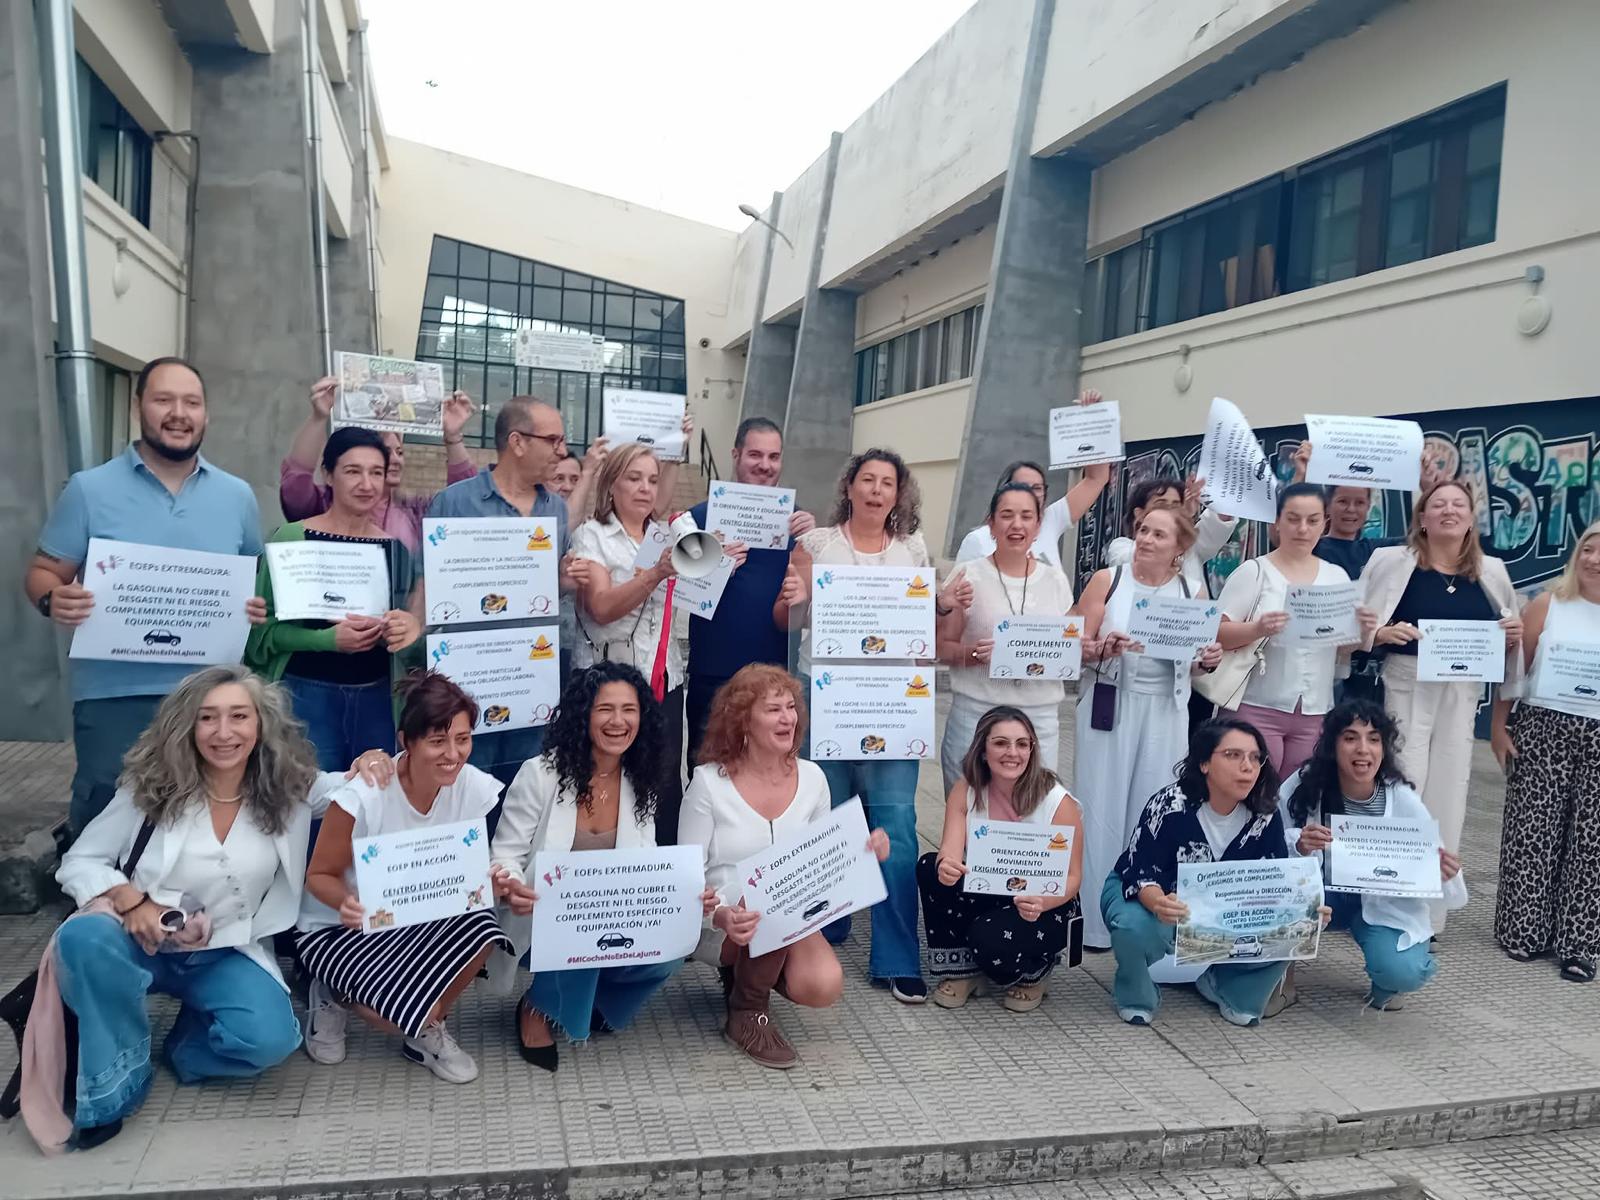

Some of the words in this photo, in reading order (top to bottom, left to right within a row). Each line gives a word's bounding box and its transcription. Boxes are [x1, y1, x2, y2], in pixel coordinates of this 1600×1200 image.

[127, 584, 173, 594] GASOLINA
[176, 587, 189, 595] NO
[192, 588, 219, 596] CUBRE
[118, 595, 162, 604] DESGASTE
[178, 598, 187, 606] EL
[105, 606, 175, 615] COMPLEMENTO
[178, 608, 224, 617] ESPECÍFICO
[125, 618, 191, 628] EQUIPARACIÓN
[194, 620, 210, 628] ¡YA!
[1008, 640, 1071, 648] ¡COMPLEMENTO
[1016, 651, 1062, 659] ESPECÍFICO!
[991, 848, 1040, 856] ORIENTACIÓN
[388, 862, 409, 872] EOEP
[411, 860, 422, 868] EN
[425, 854, 456, 866] ACCIÓN
[770, 855, 791, 870] EOEPs
[775, 864, 807, 888] GASOLINA
[808, 858, 819, 867] NO
[820, 846, 839, 861] CUBRE
[997, 858, 1042, 866] MOVIMIENTO
[575, 867, 602, 876] EOEPs
[605, 863, 674, 874] EXTREMADURA:
[972, 866, 1007, 874] ¡EXIGIMOS
[1010, 868, 1063, 877] COMPLEMENTO!
[1198, 869, 1235, 882] Orientación
[383, 883, 416, 897] CENTRO
[419, 874, 465, 891] EDUCATIVO
[772, 878, 804, 901] DESGASTE
[805, 873, 812, 881] NI
[392, 897, 409, 906] POR
[412, 888, 458, 903] DEFINICIÓN
[574, 889, 618, 898] GASOLINA
[638, 886, 665, 894] CUBRE
[766, 881, 816, 915] COMPLEMENTO
[1215, 889, 1254, 898] Responsabilidad
[567, 901, 610, 910] DESGASTE
[556, 911, 624, 922] COMPLEMENTO
[627, 907, 674, 917] ESPECÍFICO
[1223, 911, 1238, 919] EOEP
[576, 921, 642, 932] EQUIPARACIÓN
[645, 919, 661, 928] ¡YA!
